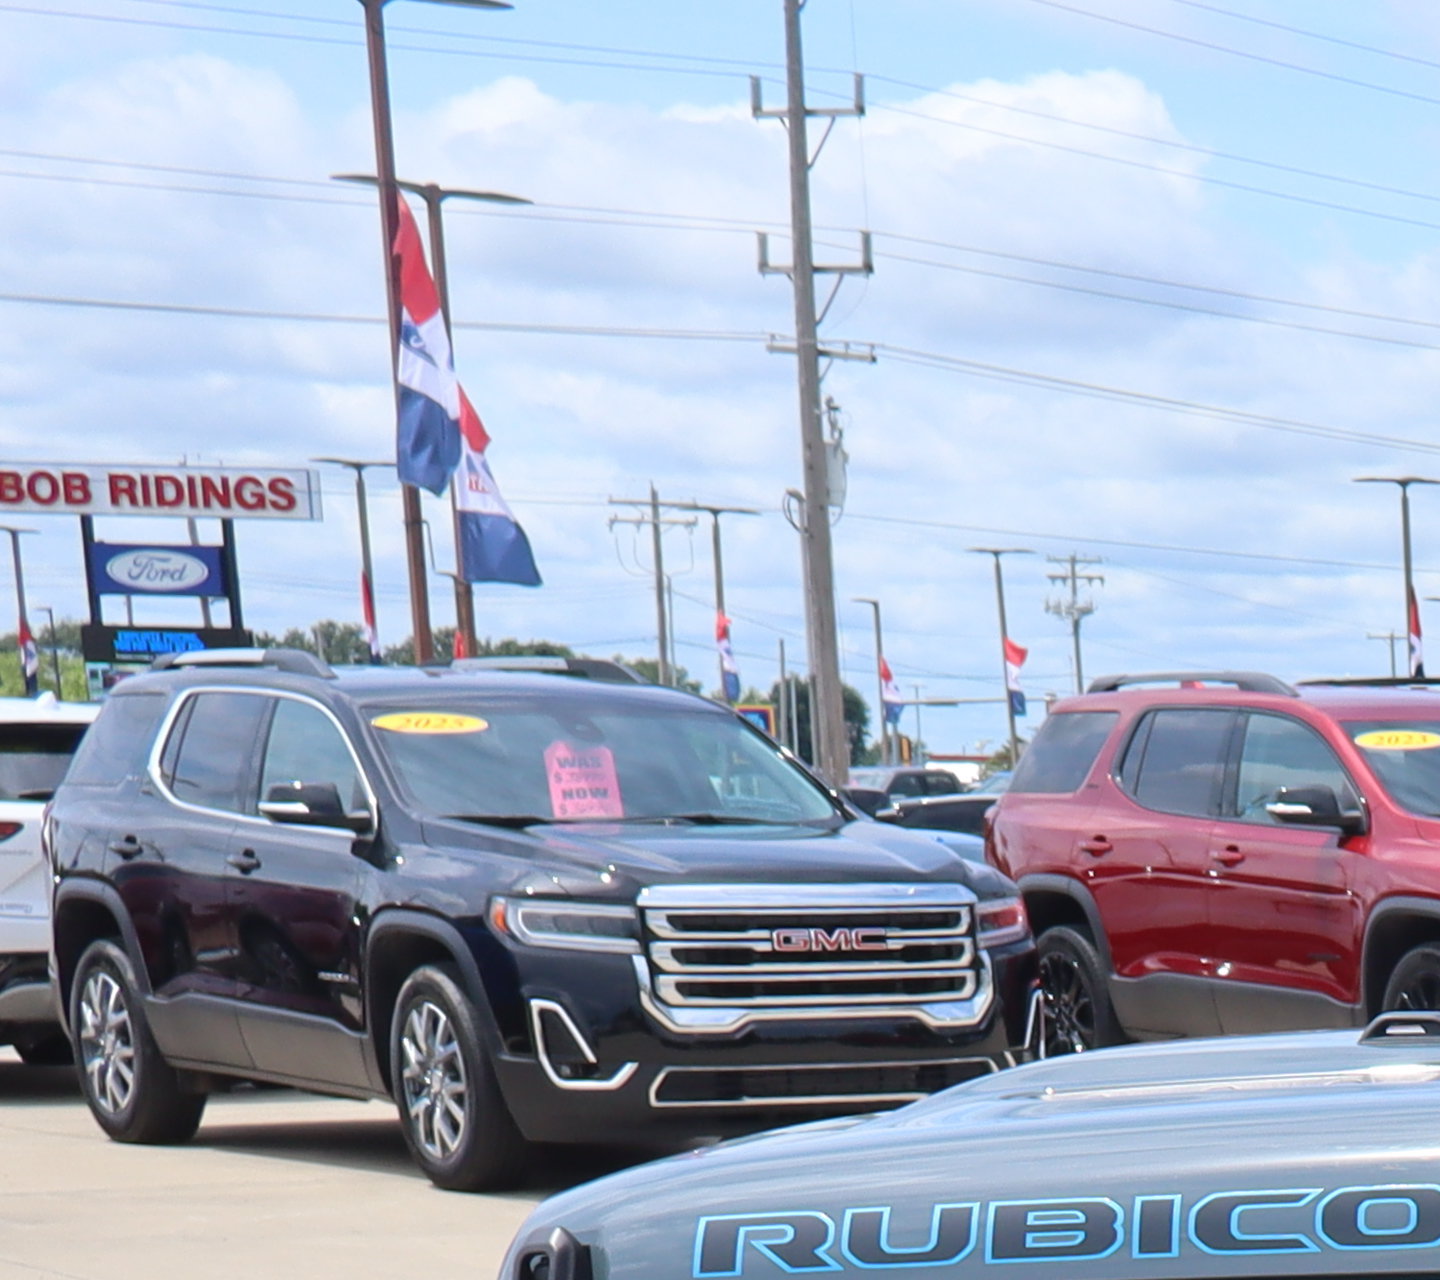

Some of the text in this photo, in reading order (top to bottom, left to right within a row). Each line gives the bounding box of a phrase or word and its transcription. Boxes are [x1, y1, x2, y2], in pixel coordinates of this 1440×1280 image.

[0, 471, 297, 511] BOB RIDINGS
[127, 556, 188, 582] Ford
[556, 756, 604, 769] WAS
[562, 787, 609, 800] NOW
[772, 927, 887, 952] GMC
